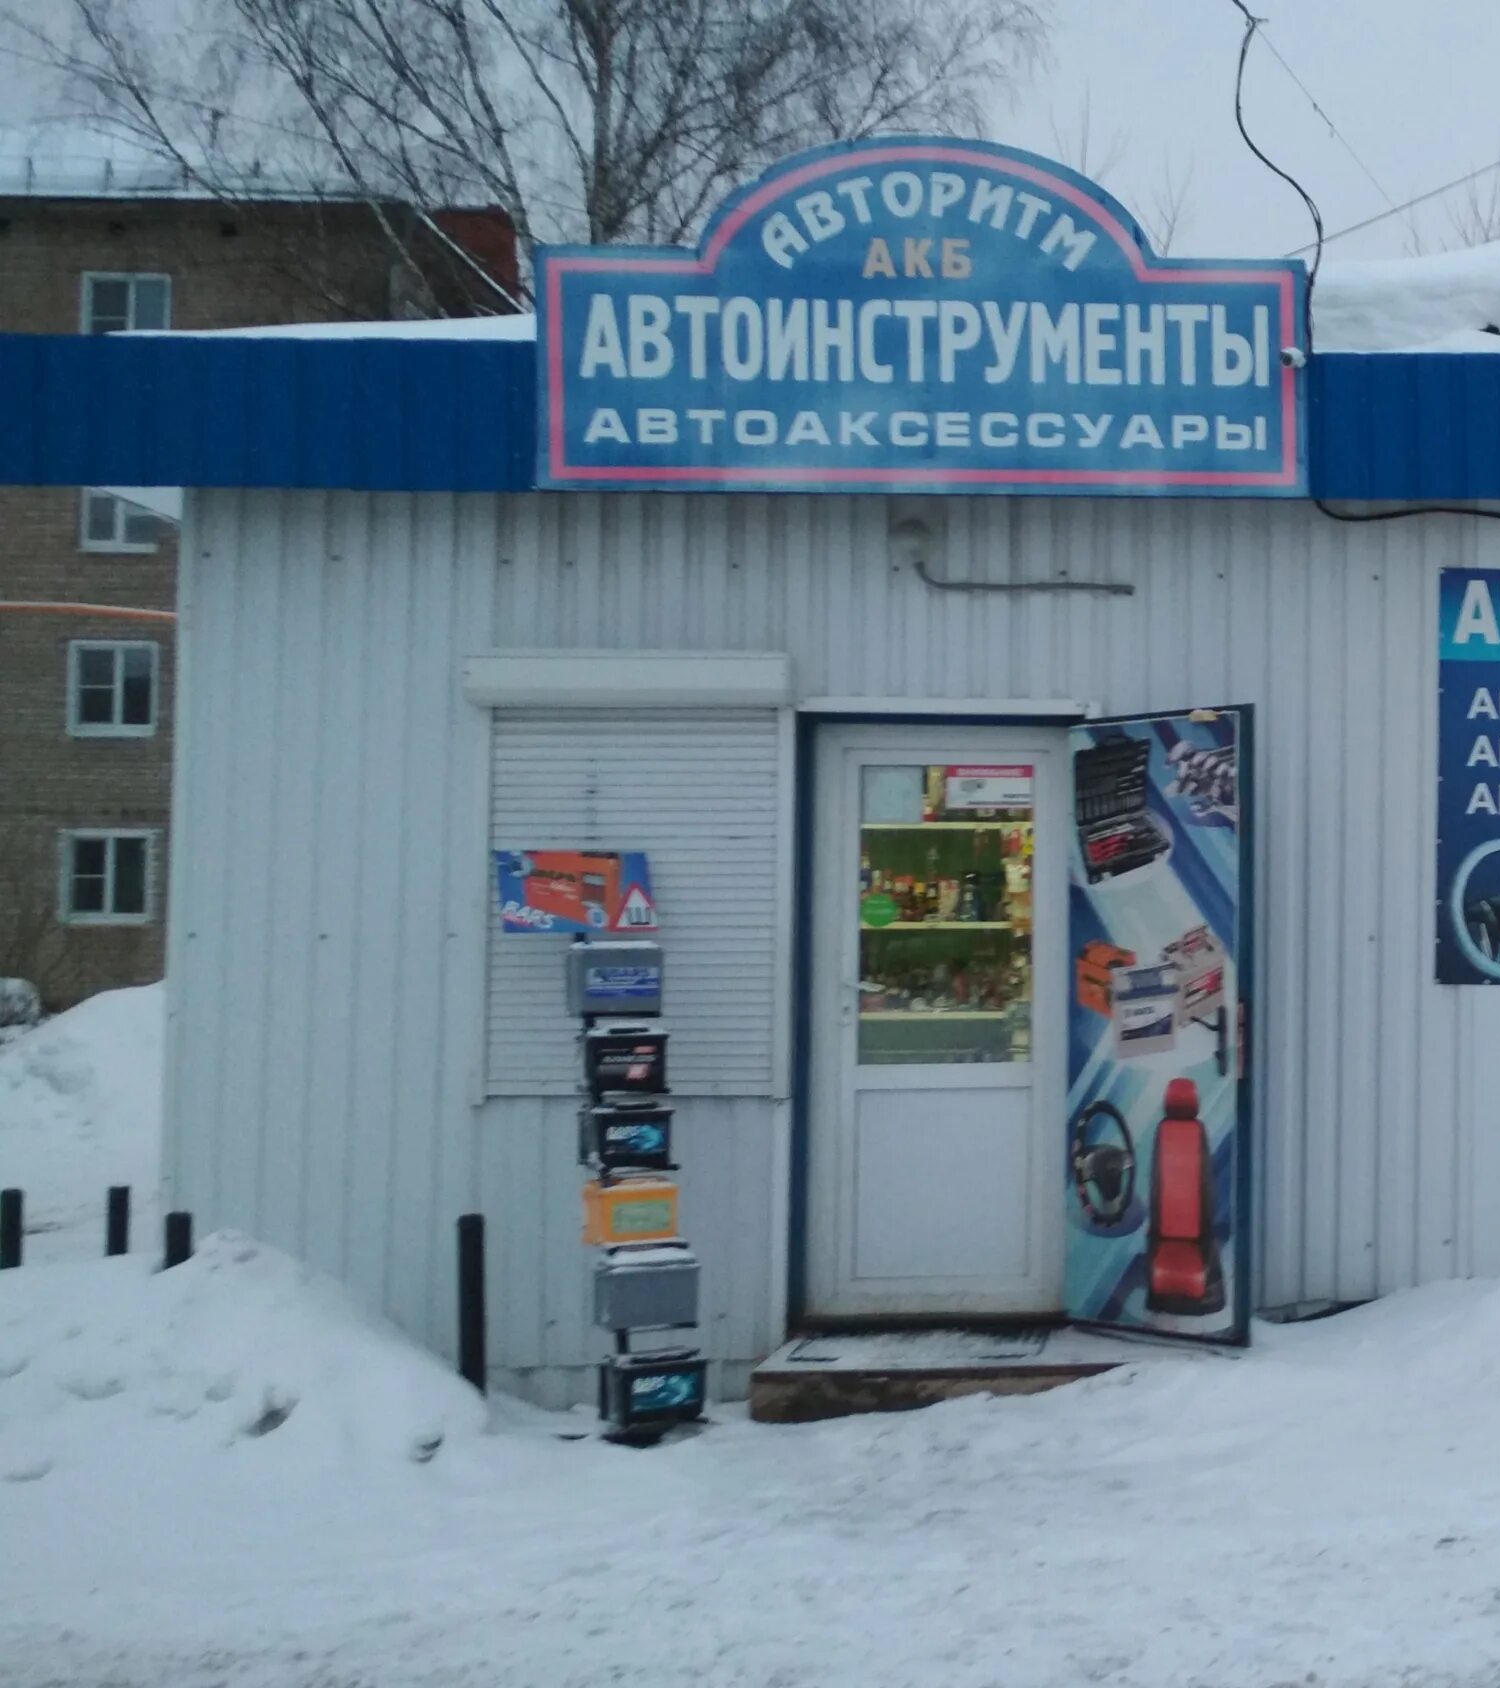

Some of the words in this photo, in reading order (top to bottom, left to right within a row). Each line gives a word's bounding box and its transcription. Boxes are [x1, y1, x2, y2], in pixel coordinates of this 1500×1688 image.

[761, 170, 1098, 273] АВТОРИТМ
[861, 236, 974, 281] АКБ
[579, 293, 1271, 388] АВТОИНСТРУМЕНТЫ
[583, 407, 1268, 452] АВТОАКСЕССУАРЫ
